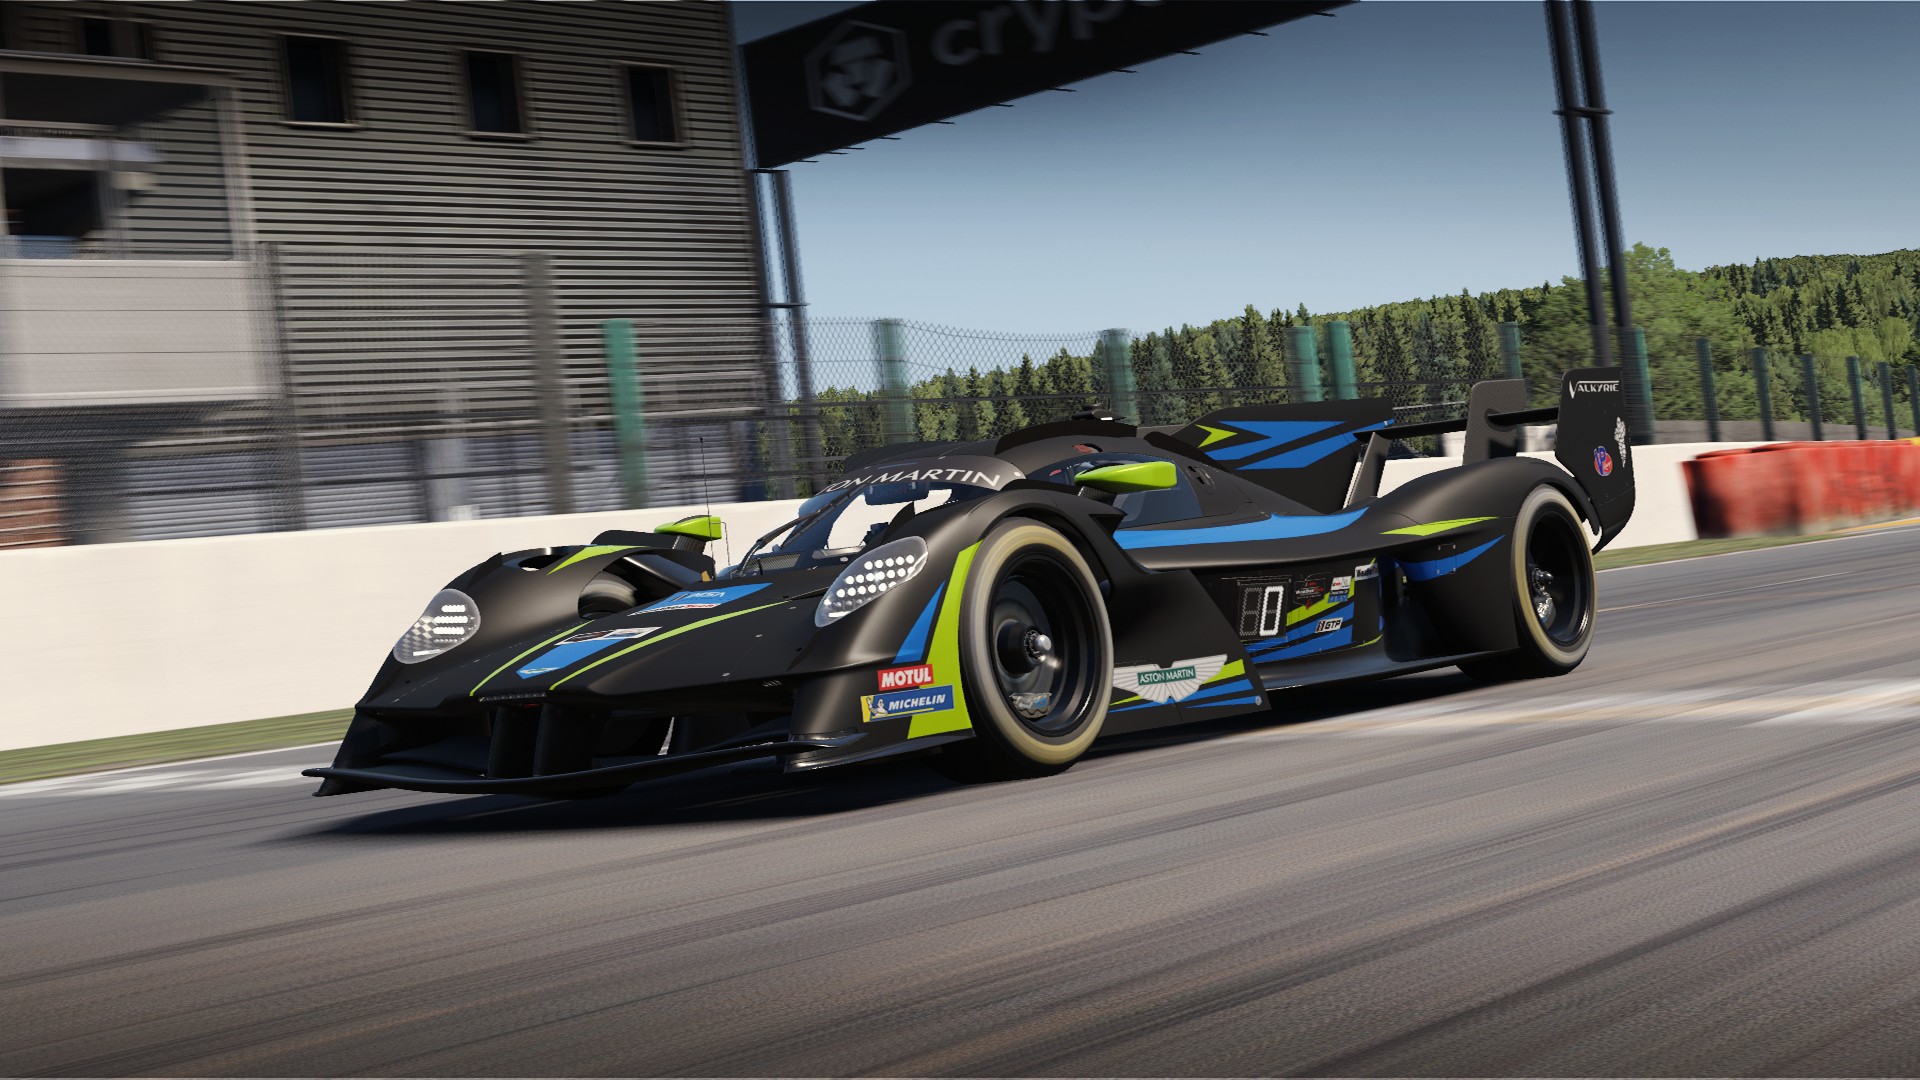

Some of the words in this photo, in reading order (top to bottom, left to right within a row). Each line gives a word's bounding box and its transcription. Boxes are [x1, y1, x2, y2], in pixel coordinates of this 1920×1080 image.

[929, 0, 1164, 65] cryp
[1568, 380, 1620, 400] VALKYRIE
[871, 468, 1000, 487] MARTIN
[881, 667, 932, 688] MOTUL
[1139, 671, 1166, 684] ASTON
[1166, 668, 1195, 681] MARTIN
[888, 694, 946, 711] MICHELIN
